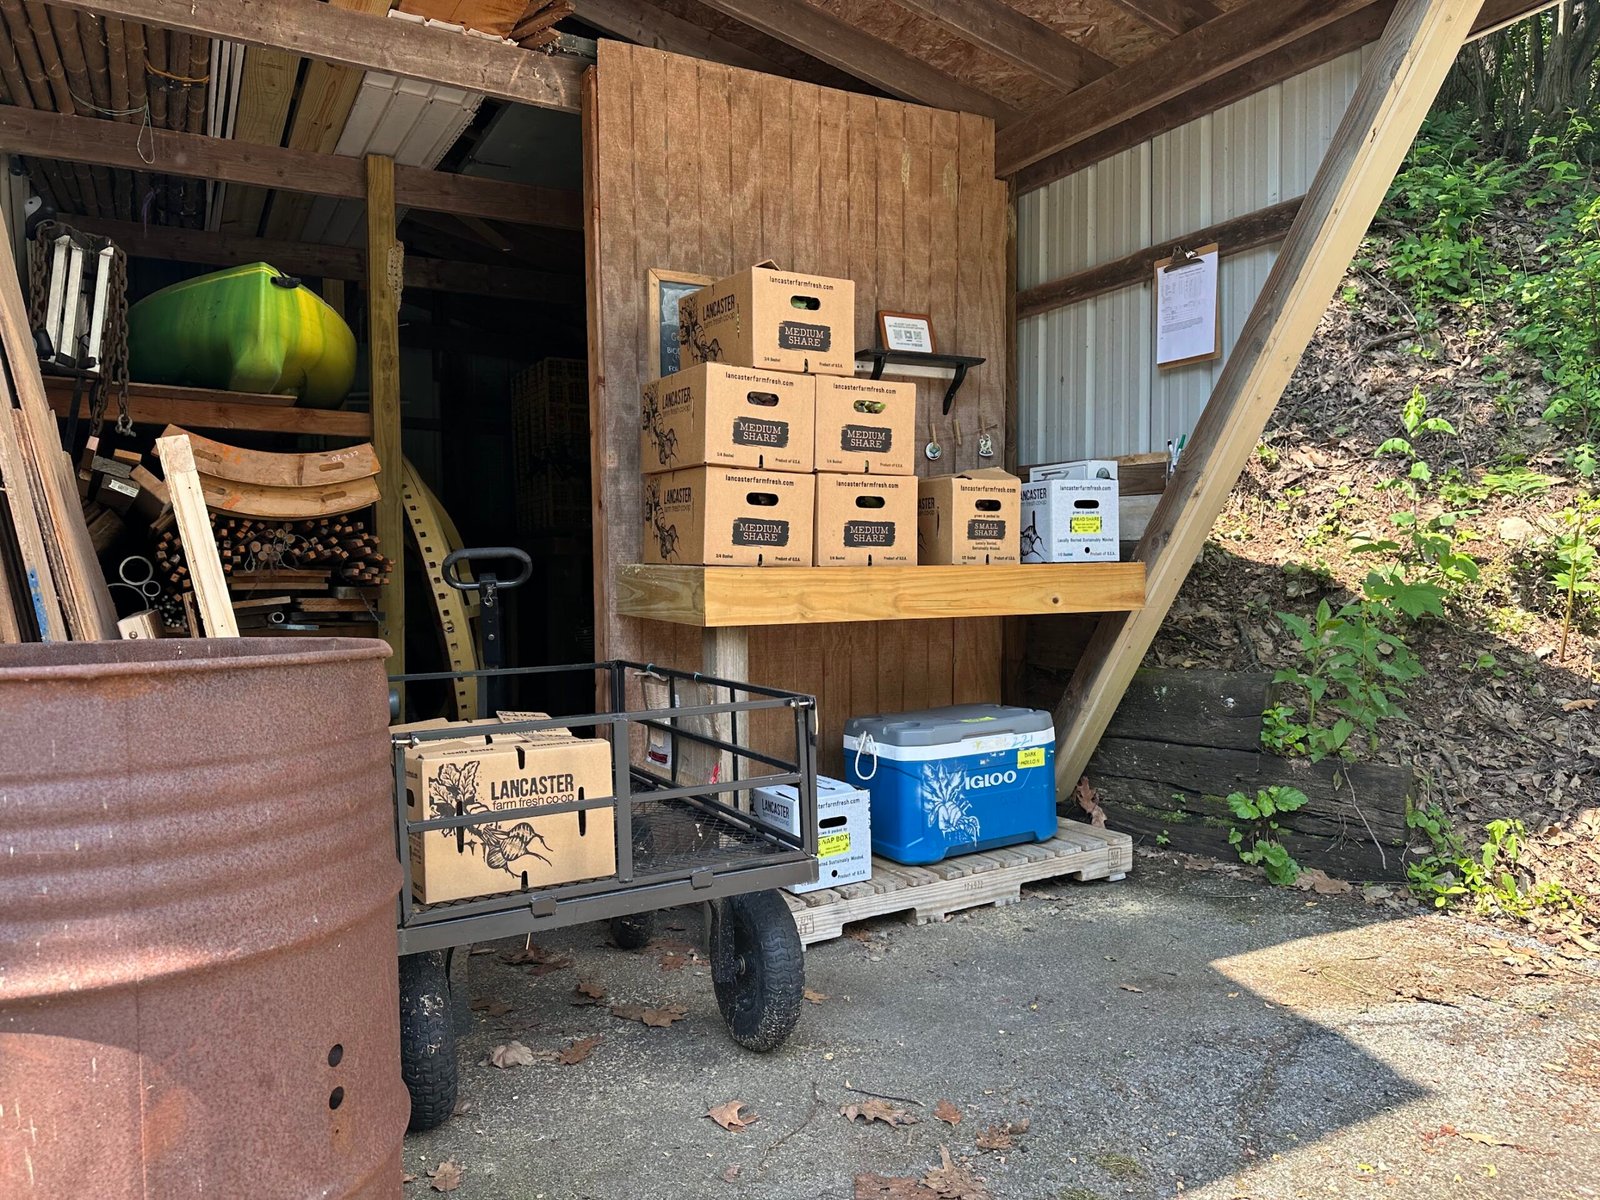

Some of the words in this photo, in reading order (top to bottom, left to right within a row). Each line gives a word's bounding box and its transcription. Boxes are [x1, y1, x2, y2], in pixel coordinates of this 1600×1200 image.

[769, 276, 834, 290] lancasterfarmfresh.com
[702, 294, 735, 321] LANCASTER
[784, 326, 824, 338] MEDIUM
[788, 336, 821, 347] SHARE
[726, 371, 794, 386] lancasterfarmfresh.com
[833, 383, 896, 394] lancasterfarmfresh.com
[662, 386, 691, 410] LANCASTER
[740, 422, 782, 434] MEDIUM
[743, 432, 778, 442] SHARE
[847, 430, 886, 440] MEDIUM
[850, 438, 882, 448] SHARE
[726, 474, 794, 486] lancasterfarmfresh.com
[836, 480, 899, 488] lancasterfarmfresh.com
[664, 486, 692, 504] LANCASTER
[960, 485, 1016, 493] lancasterfarmfresh.com
[1020, 488, 1047, 502] ANCASTER
[740, 523, 782, 534] MEDIUM
[850, 526, 889, 534] MEDIUM
[974, 522, 998, 530] SMALL
[743, 532, 778, 542] SHARE
[854, 534, 886, 542] SHARE
[964, 770, 1017, 790] IGLOO
[490, 774, 574, 800] LANCASTER
[493, 800, 516, 810] farm
[519, 796, 545, 808] fresh
[546, 793, 574, 804] co-op
[818, 798, 860, 810] terfarmfresh.com
[761, 798, 790, 819] LANCASTER
[836, 834, 848, 842] BOX
